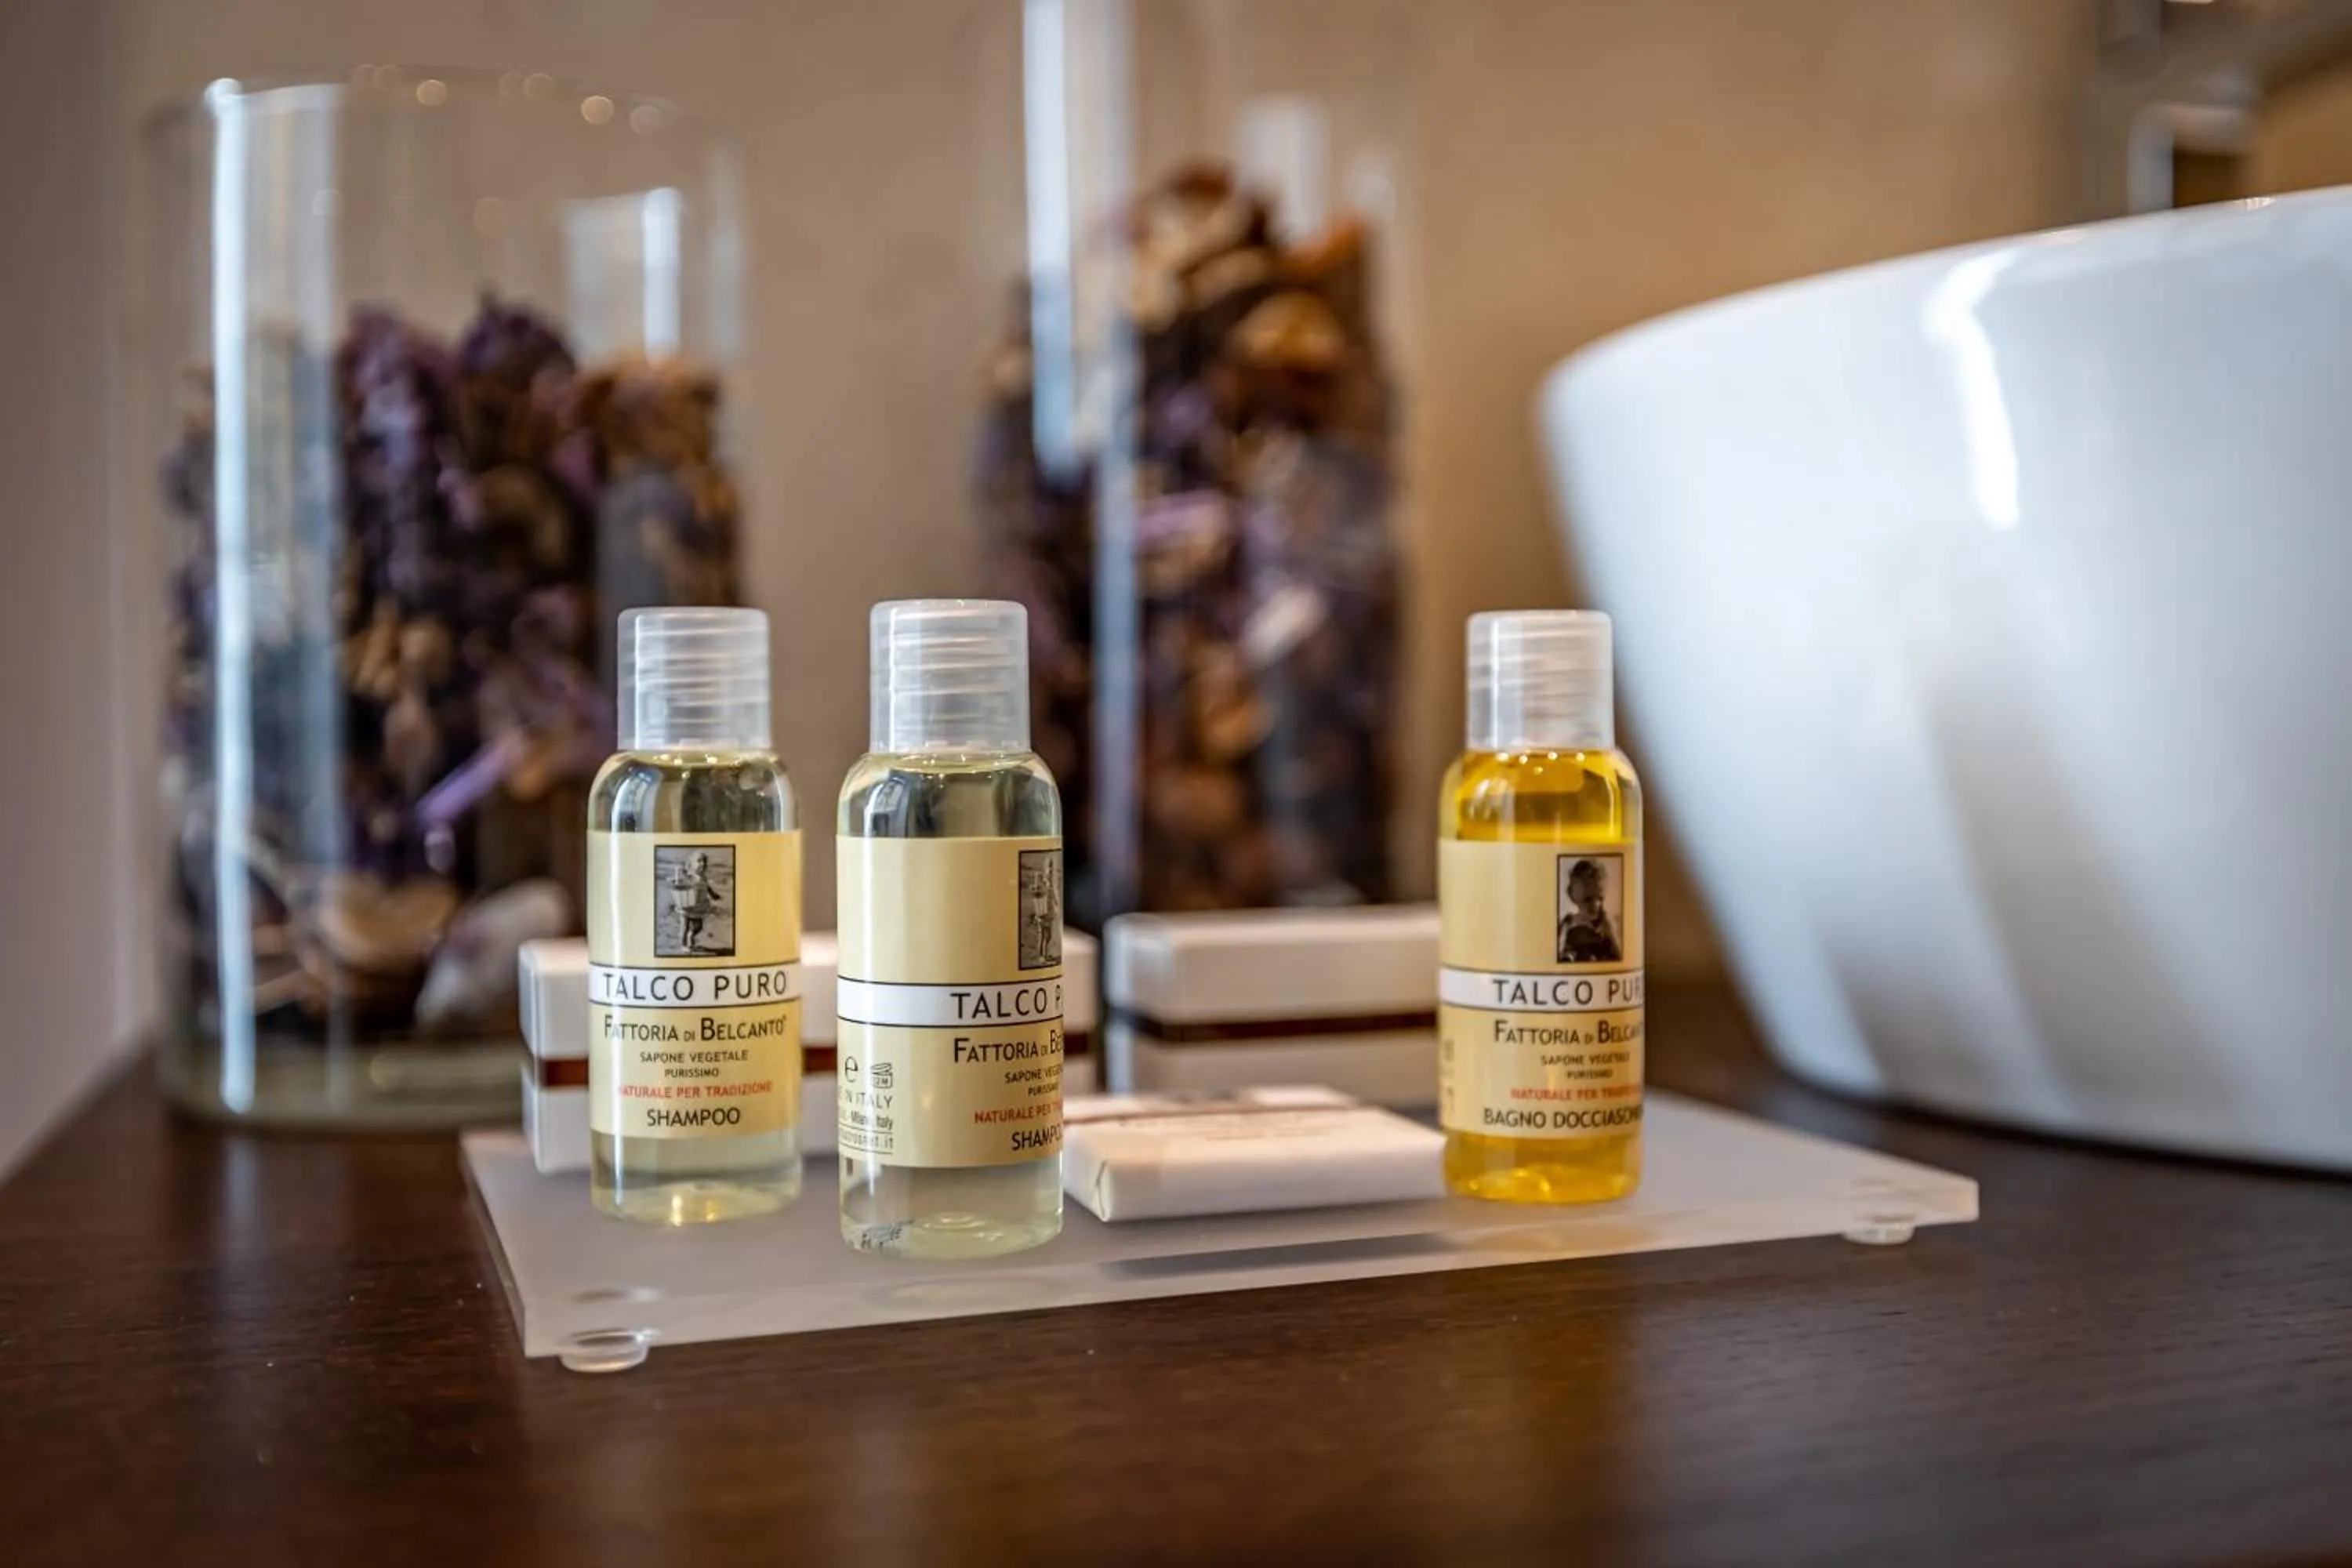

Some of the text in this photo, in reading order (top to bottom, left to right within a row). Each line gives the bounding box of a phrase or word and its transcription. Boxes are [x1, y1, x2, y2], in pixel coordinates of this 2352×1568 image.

[603, 971, 787, 1001] TALCO PURO
[1493, 979, 1593, 1006] TALCO
[950, 987, 1047, 1019] TALCO
[1494, 1019, 1581, 1046] FATTORIA
[640, 1049, 749, 1064] SAPONE VEGETALE
[954, 1037, 1039, 1063] FATTORIA
[1541, 1054, 1584, 1066] SAPONE
[665, 1067, 720, 1078] PURISSIMO
[1004, 1069, 1041, 1083] SAPONE
[677, 1086, 700, 1098] PER
[706, 1080, 772, 1097] TRADIZIONE
[1511, 1087, 1572, 1101] NATURALE
[647, 1107, 741, 1127] SHAMPOO
[975, 1107, 1034, 1123] NATURALE
[1483, 1108, 1546, 1129] BAGNO
